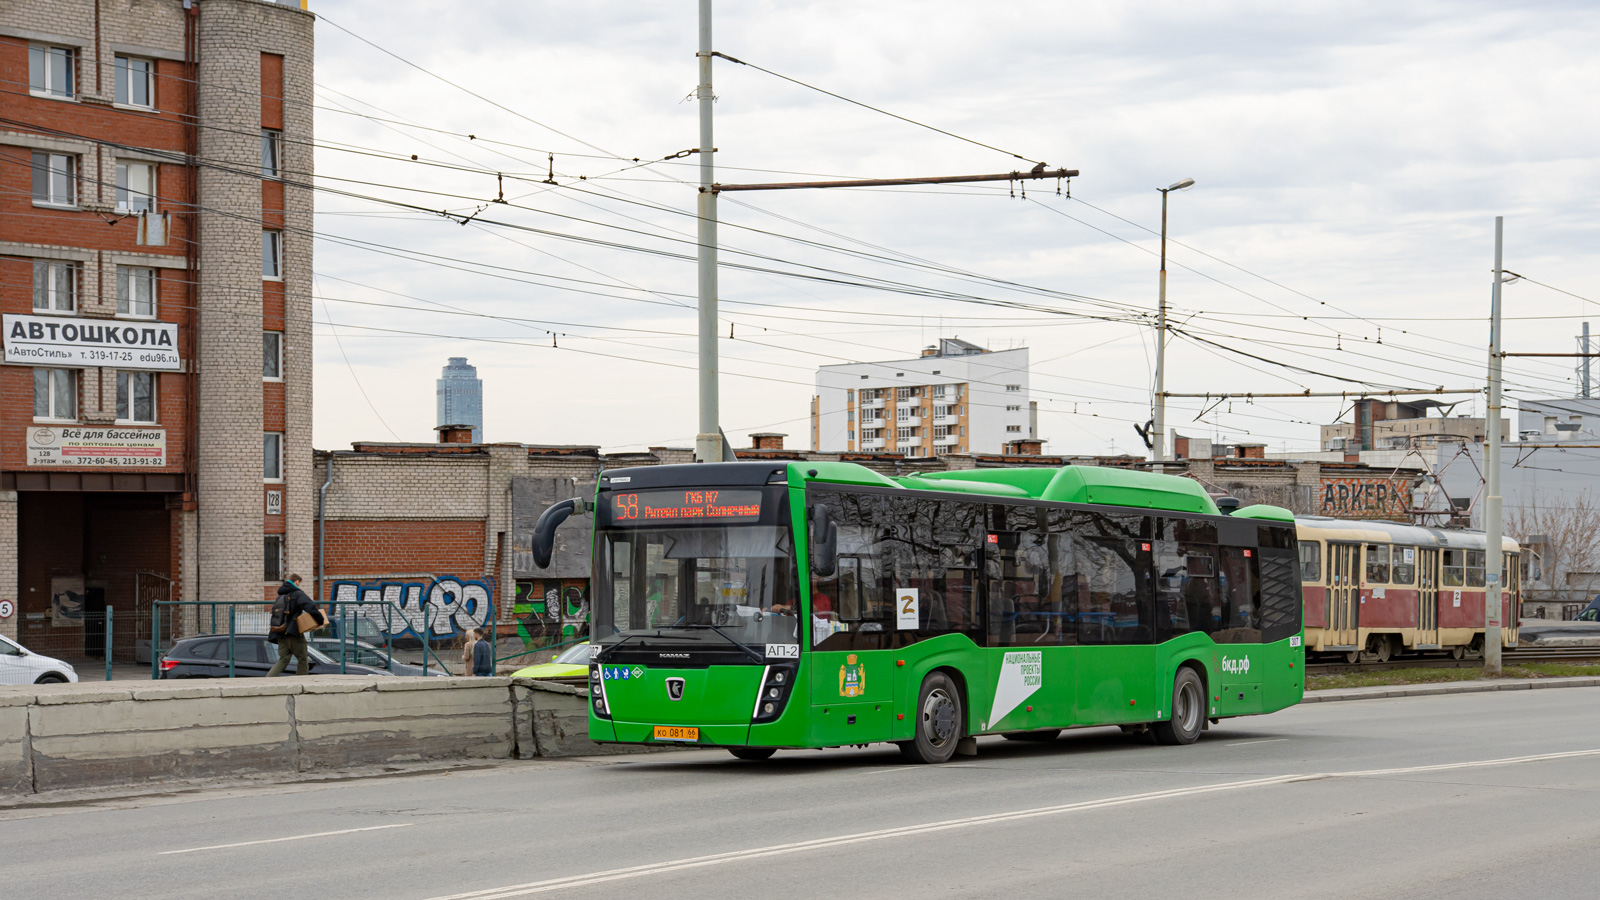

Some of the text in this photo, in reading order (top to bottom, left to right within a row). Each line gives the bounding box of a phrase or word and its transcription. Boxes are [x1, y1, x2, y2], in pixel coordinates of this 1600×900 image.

[10, 321, 173, 346] АВТОШКОЛА
[8, 347, 178, 363] «АвтоСтиль» т. 319-17-25 edu96.ru
[62, 428, 161, 439] Всё для бассейнов
[77, 457, 120, 465] 372-60-45,
[268, 494, 279, 506] 128
[685, 491, 719, 504] ГКБ N7
[617, 494, 638, 519] 58
[645, 504, 760, 519] Ритейл парк Солнечный
[2, 604, 8, 614] 5
[768, 646, 798, 656] АП-2
[1006, 653, 1040, 664] НАЦИОНАЛЬНЫЕ
[1222, 654, 1250, 674] бкд.рф
[1021, 664, 1040, 675] ПРОЕКТЫ
[1024, 675, 1040, 686] РОССИИ
[670, 728, 684, 737] 081
